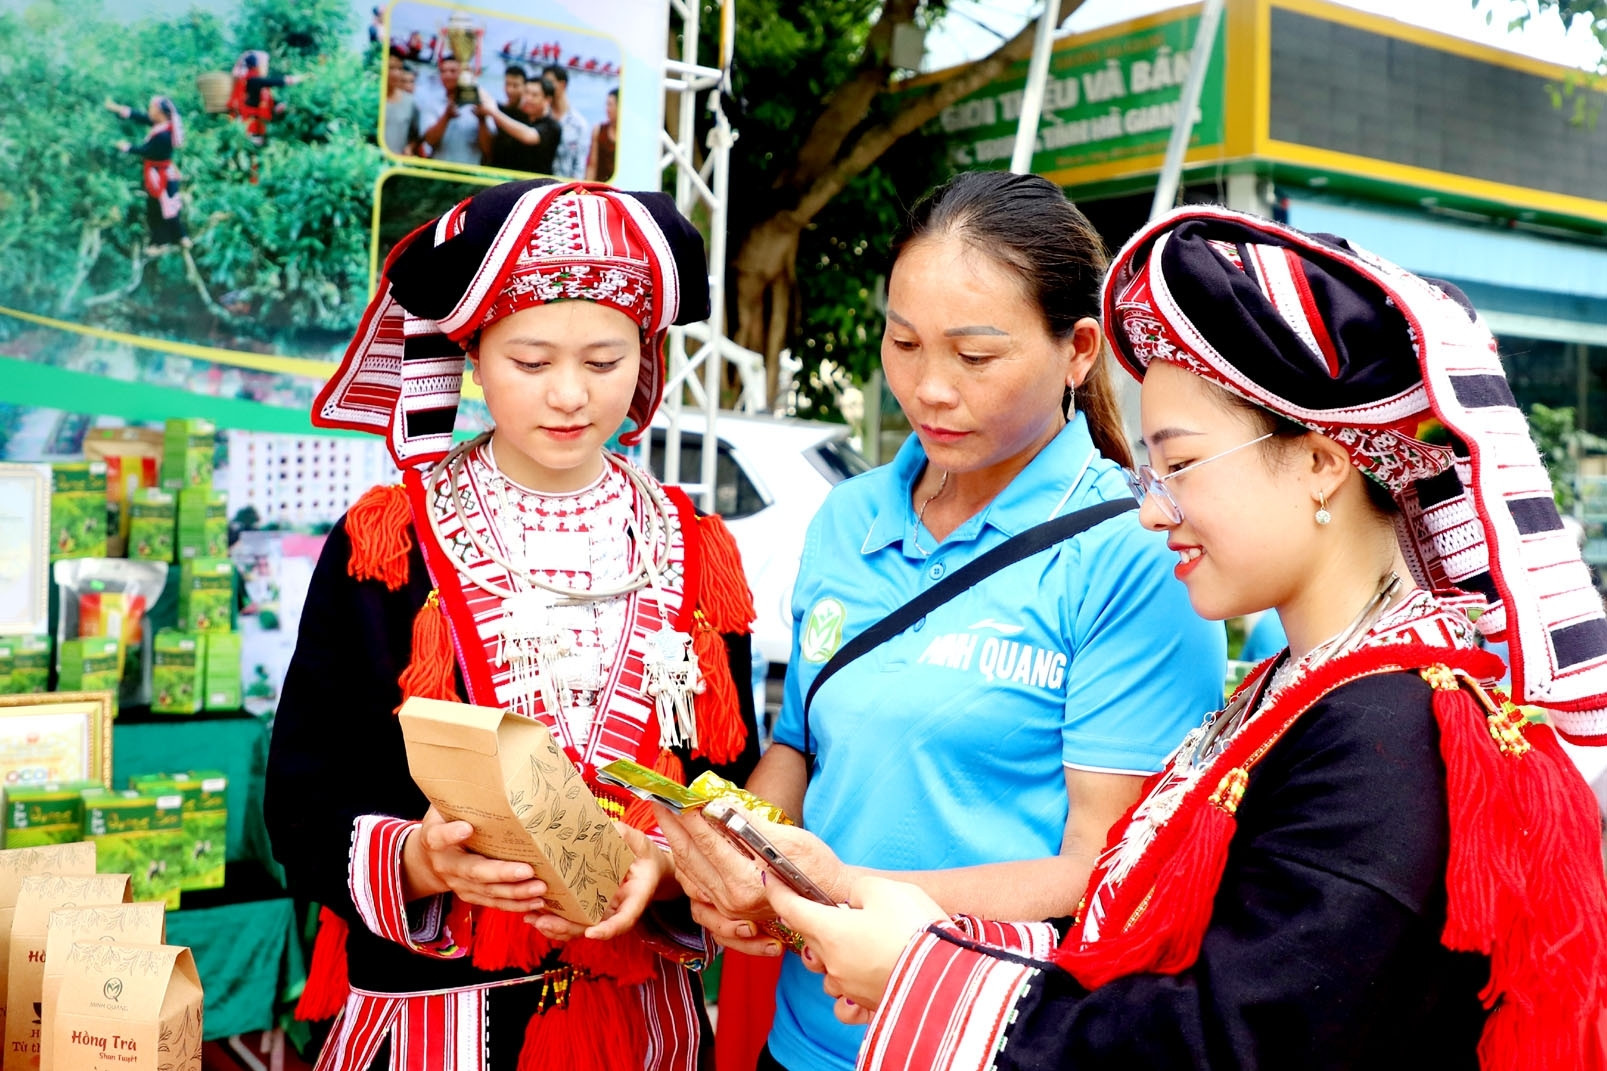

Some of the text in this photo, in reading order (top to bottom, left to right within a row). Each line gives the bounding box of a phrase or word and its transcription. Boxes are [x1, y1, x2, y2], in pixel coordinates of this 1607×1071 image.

[998, 74, 1079, 121] TỆU
[979, 637, 1067, 690] QUANG
[99, 1052, 116, 1061] Shan
[112, 1035, 137, 1052] Trà
